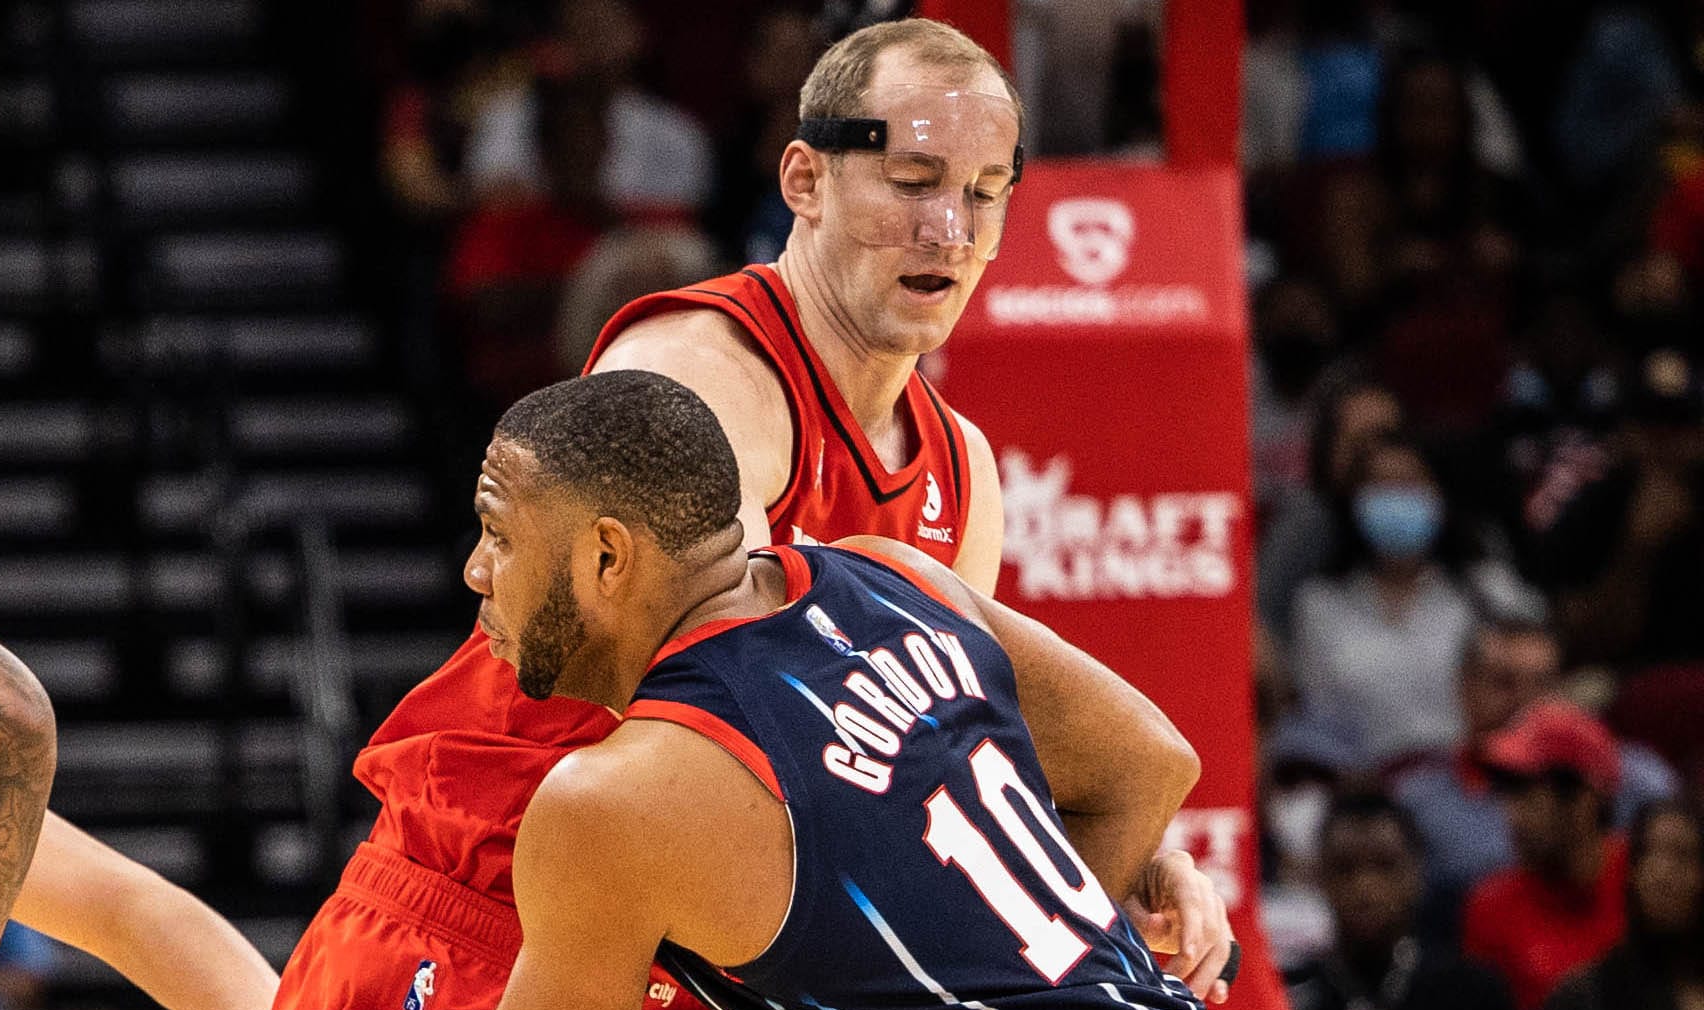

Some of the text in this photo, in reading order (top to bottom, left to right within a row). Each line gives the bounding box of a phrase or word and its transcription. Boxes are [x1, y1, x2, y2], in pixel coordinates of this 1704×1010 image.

[1020, 548, 1235, 598] KINGS
[822, 631, 987, 796] GORDON
[921, 737, 1118, 987] 10
